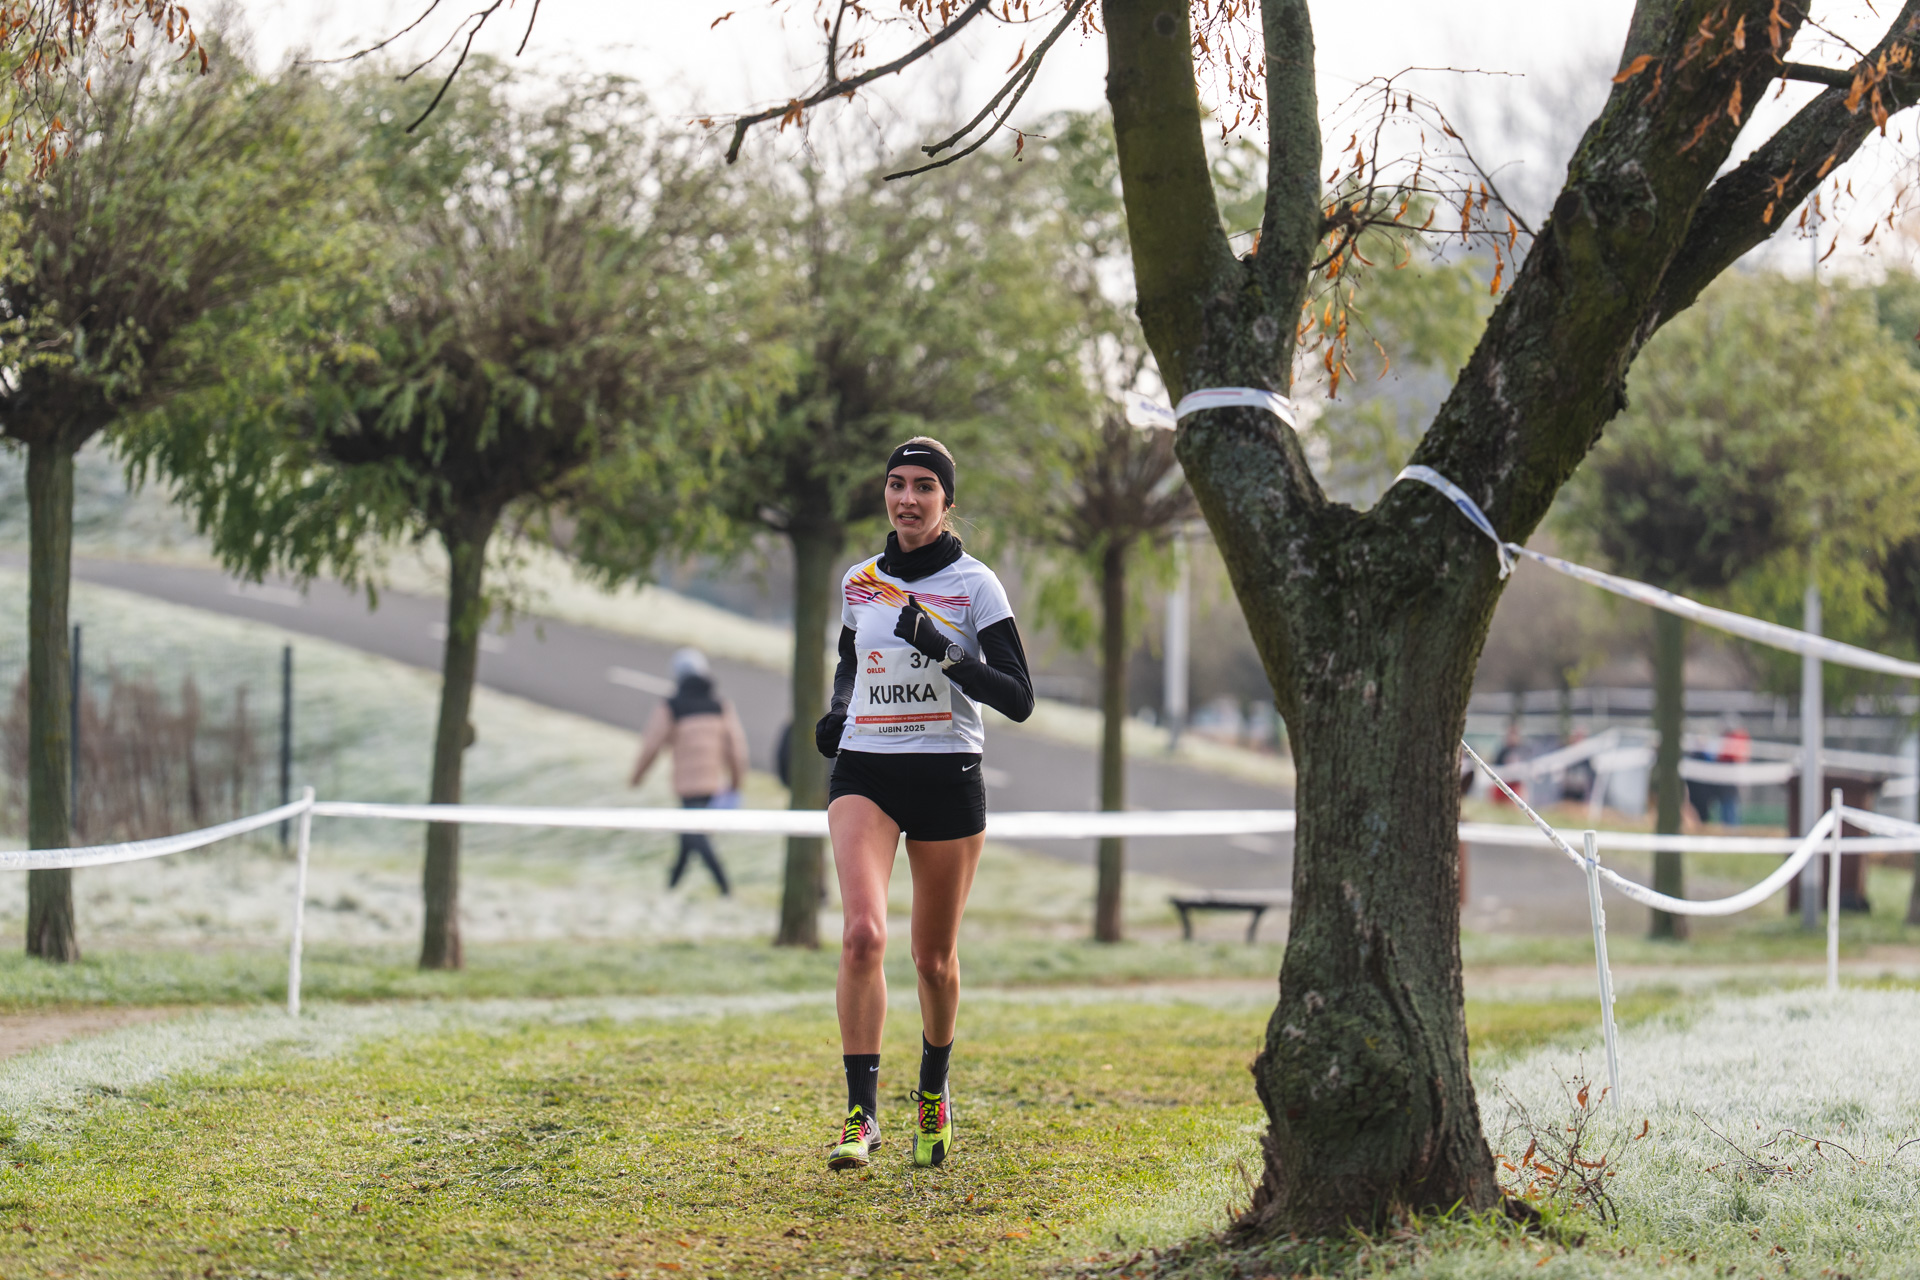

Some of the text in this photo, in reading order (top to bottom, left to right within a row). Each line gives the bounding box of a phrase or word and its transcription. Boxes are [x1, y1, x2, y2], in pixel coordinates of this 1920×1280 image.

[869, 683, 938, 705] KURKA
[878, 724, 926, 734] LUBIN 2025
